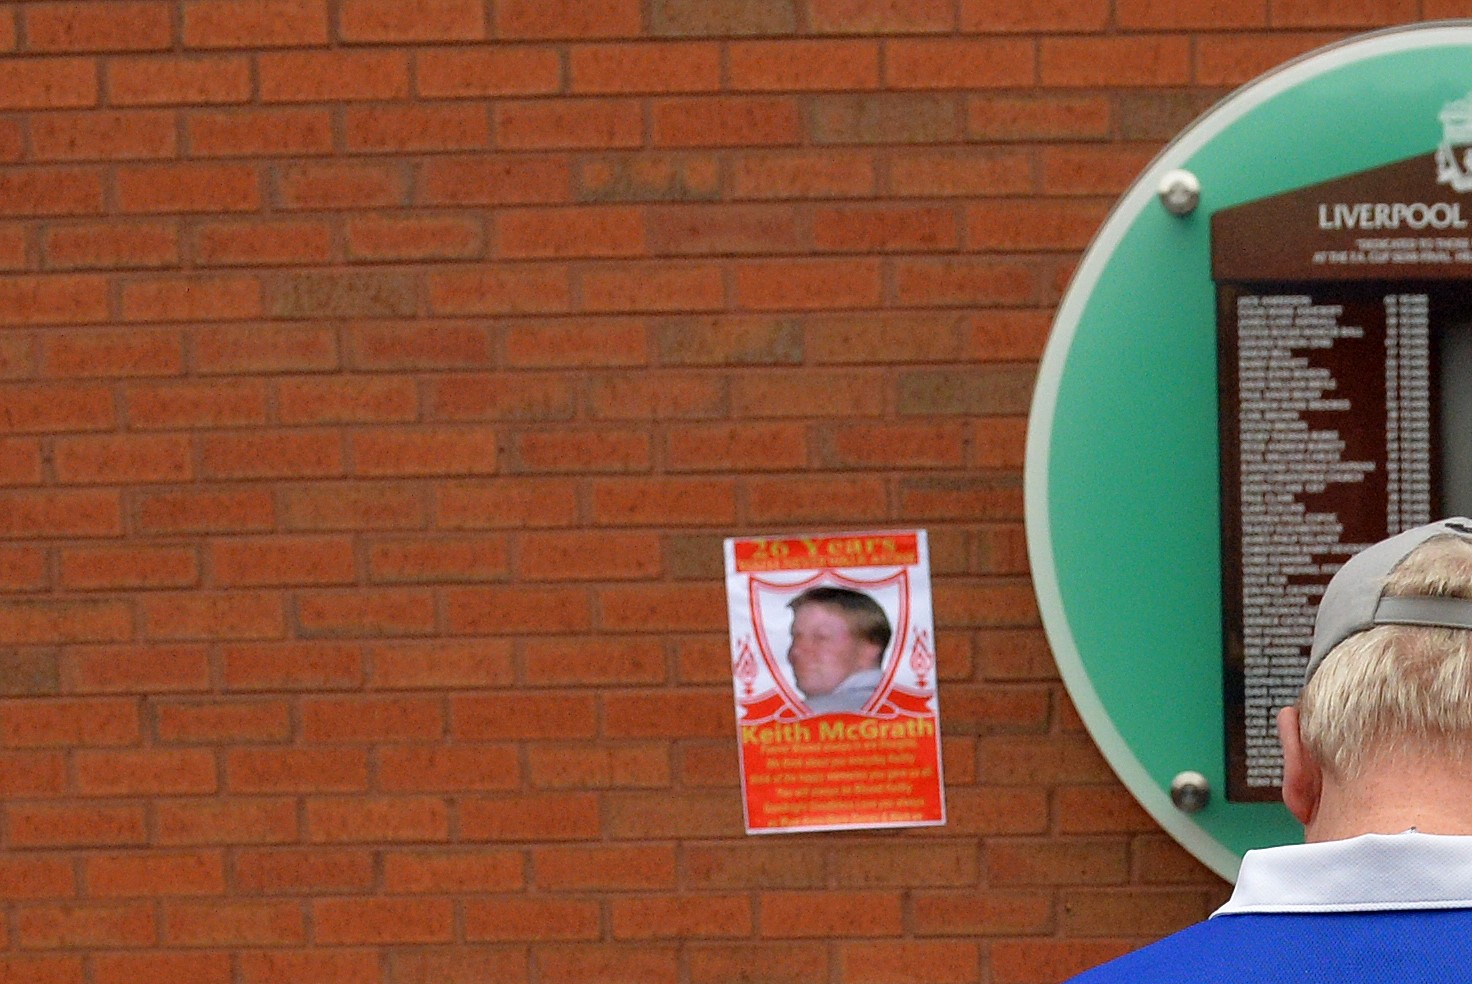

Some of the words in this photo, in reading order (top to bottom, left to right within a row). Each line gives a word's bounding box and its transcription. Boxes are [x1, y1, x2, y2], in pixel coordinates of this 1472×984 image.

[1318, 202, 1468, 230] LIVERPOOL
[742, 723, 812, 744] Keith
[818, 716, 935, 742] McGrath
